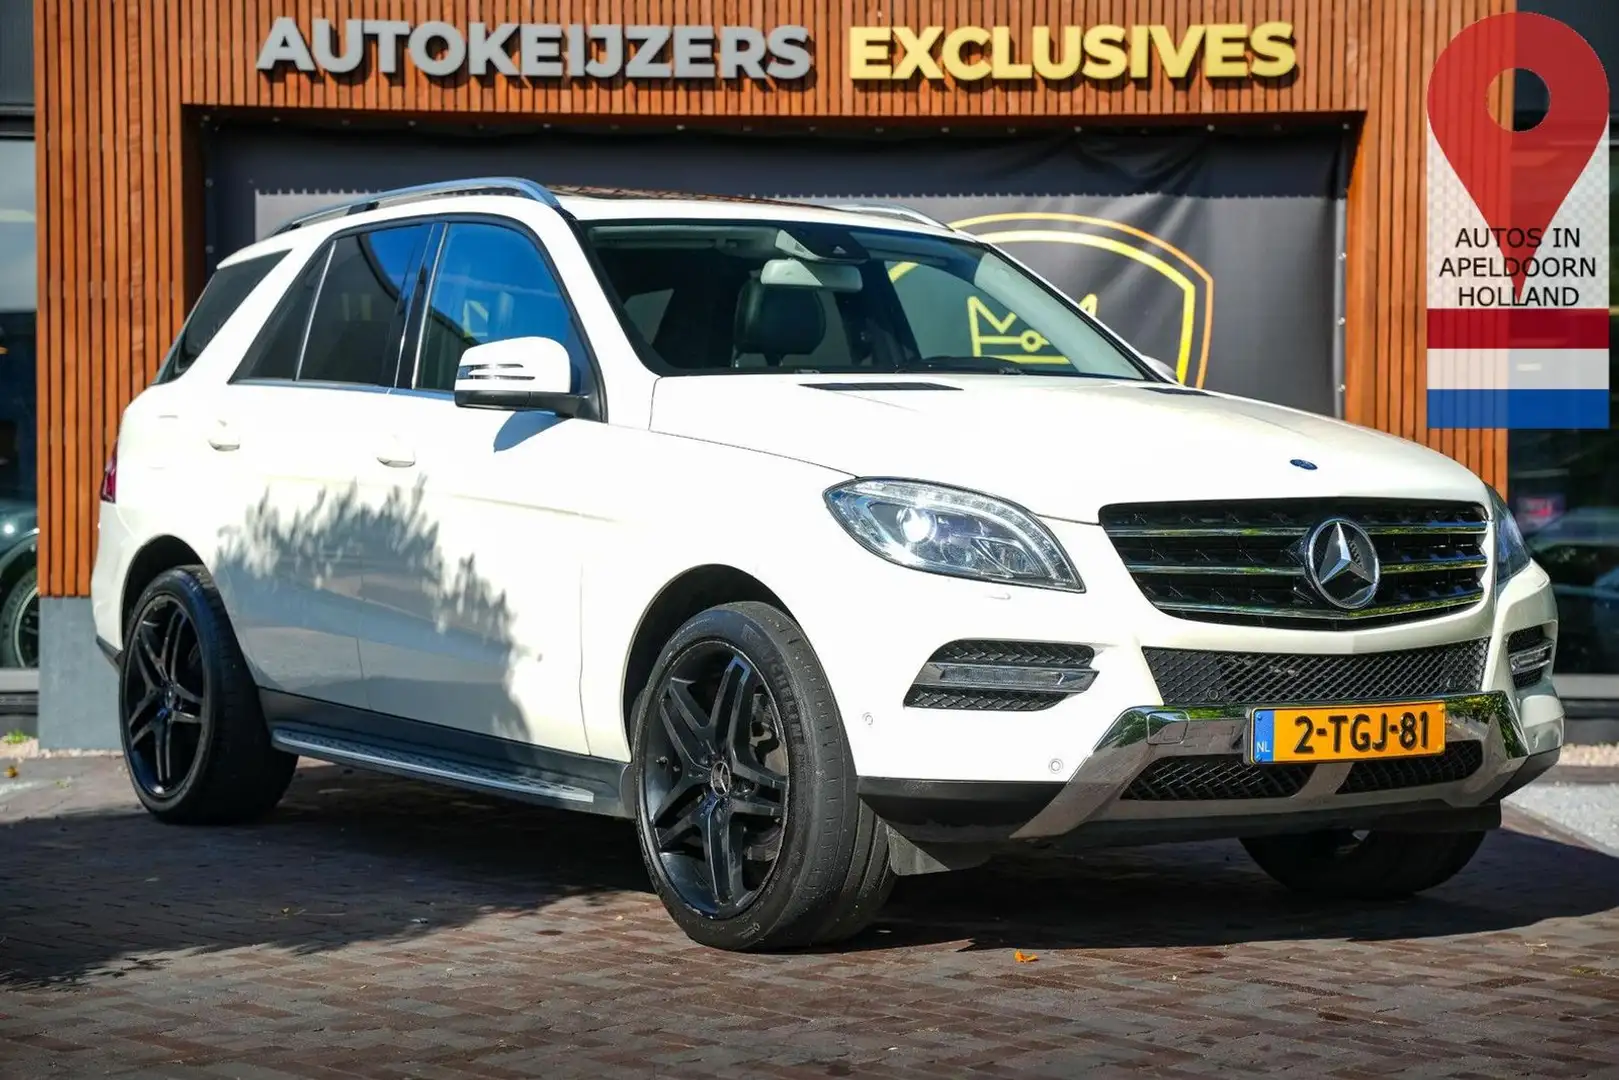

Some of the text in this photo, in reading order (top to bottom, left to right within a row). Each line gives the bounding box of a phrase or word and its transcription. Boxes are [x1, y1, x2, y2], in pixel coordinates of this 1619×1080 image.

[256, 16, 1297, 81] AUTOKEIJZERS EXCLUSIVES
[1256, 710, 1430, 754] NL 2-TGJ-81
